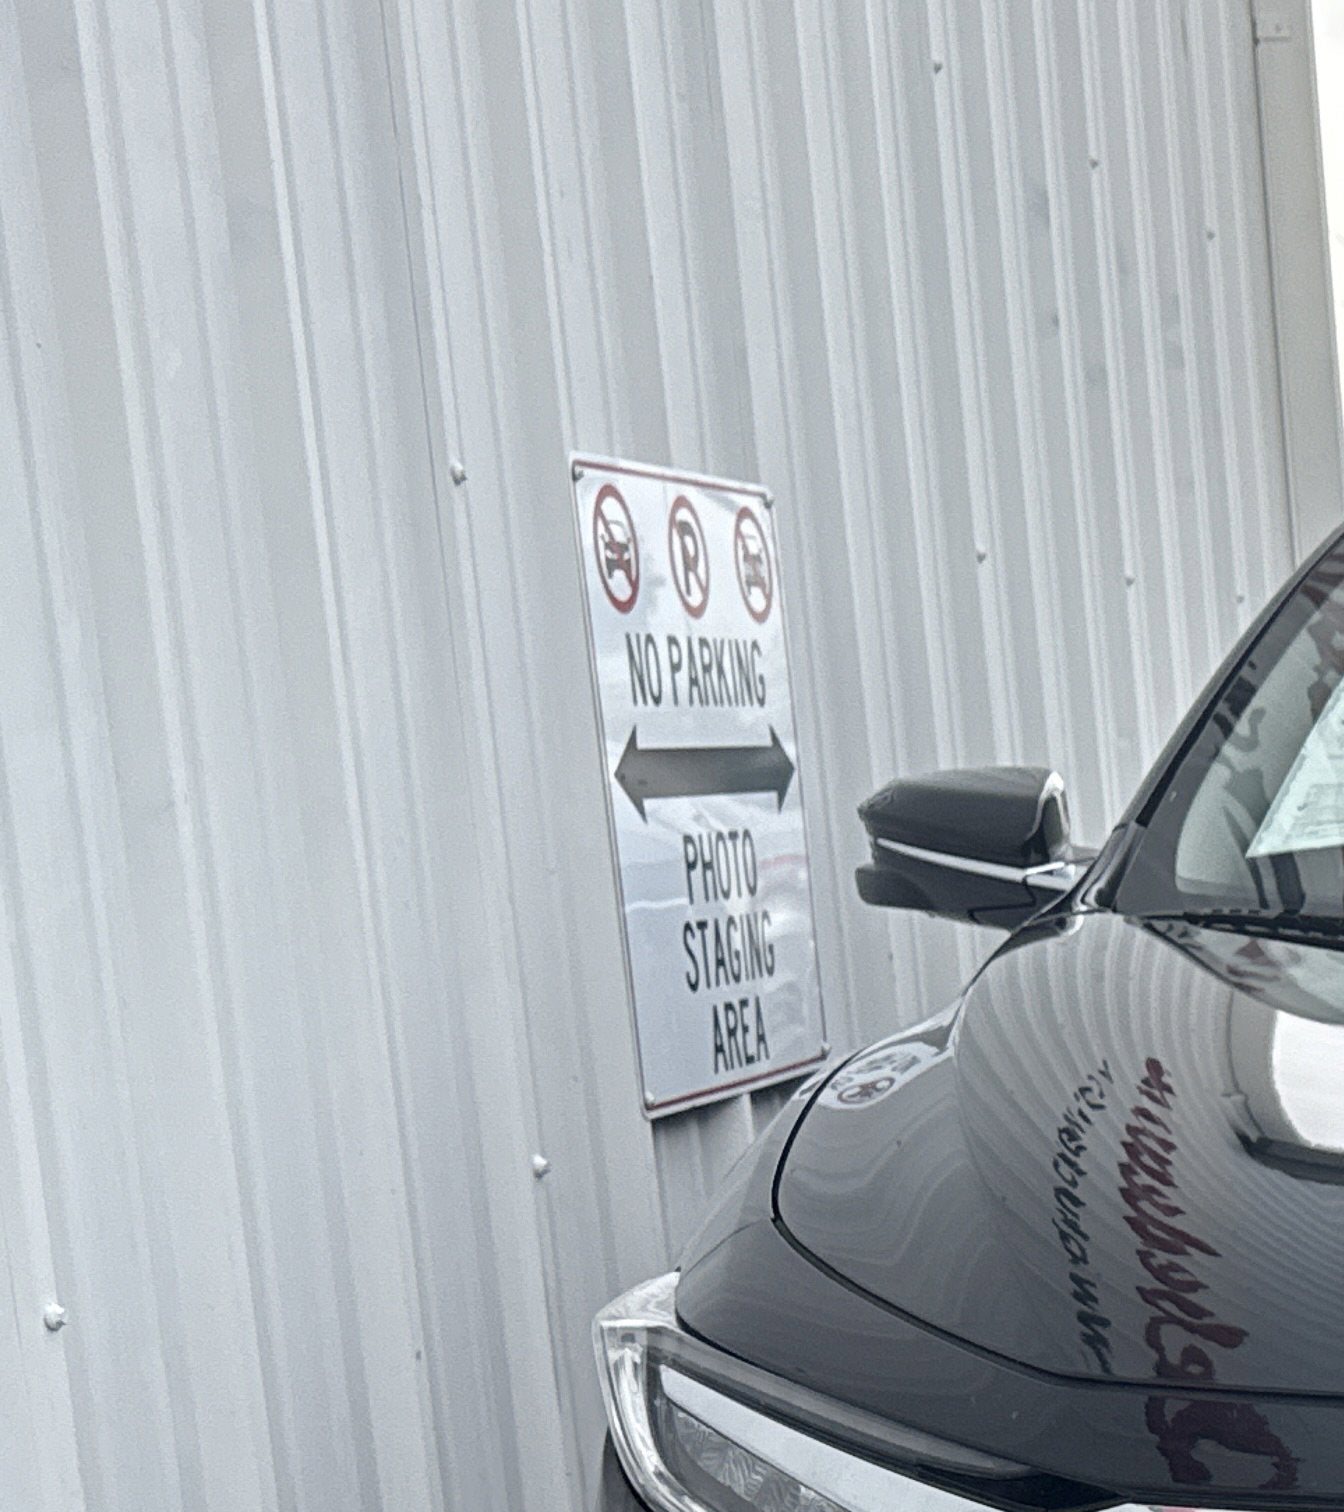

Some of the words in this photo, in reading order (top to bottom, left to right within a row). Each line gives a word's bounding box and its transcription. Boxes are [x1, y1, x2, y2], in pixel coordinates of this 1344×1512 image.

[625, 632, 662, 708] NO
[667, 633, 767, 707] PARKING
[682, 830, 758, 905] PHOTO
[682, 910, 775, 992] STAGING
[712, 996, 770, 1075] AREA
